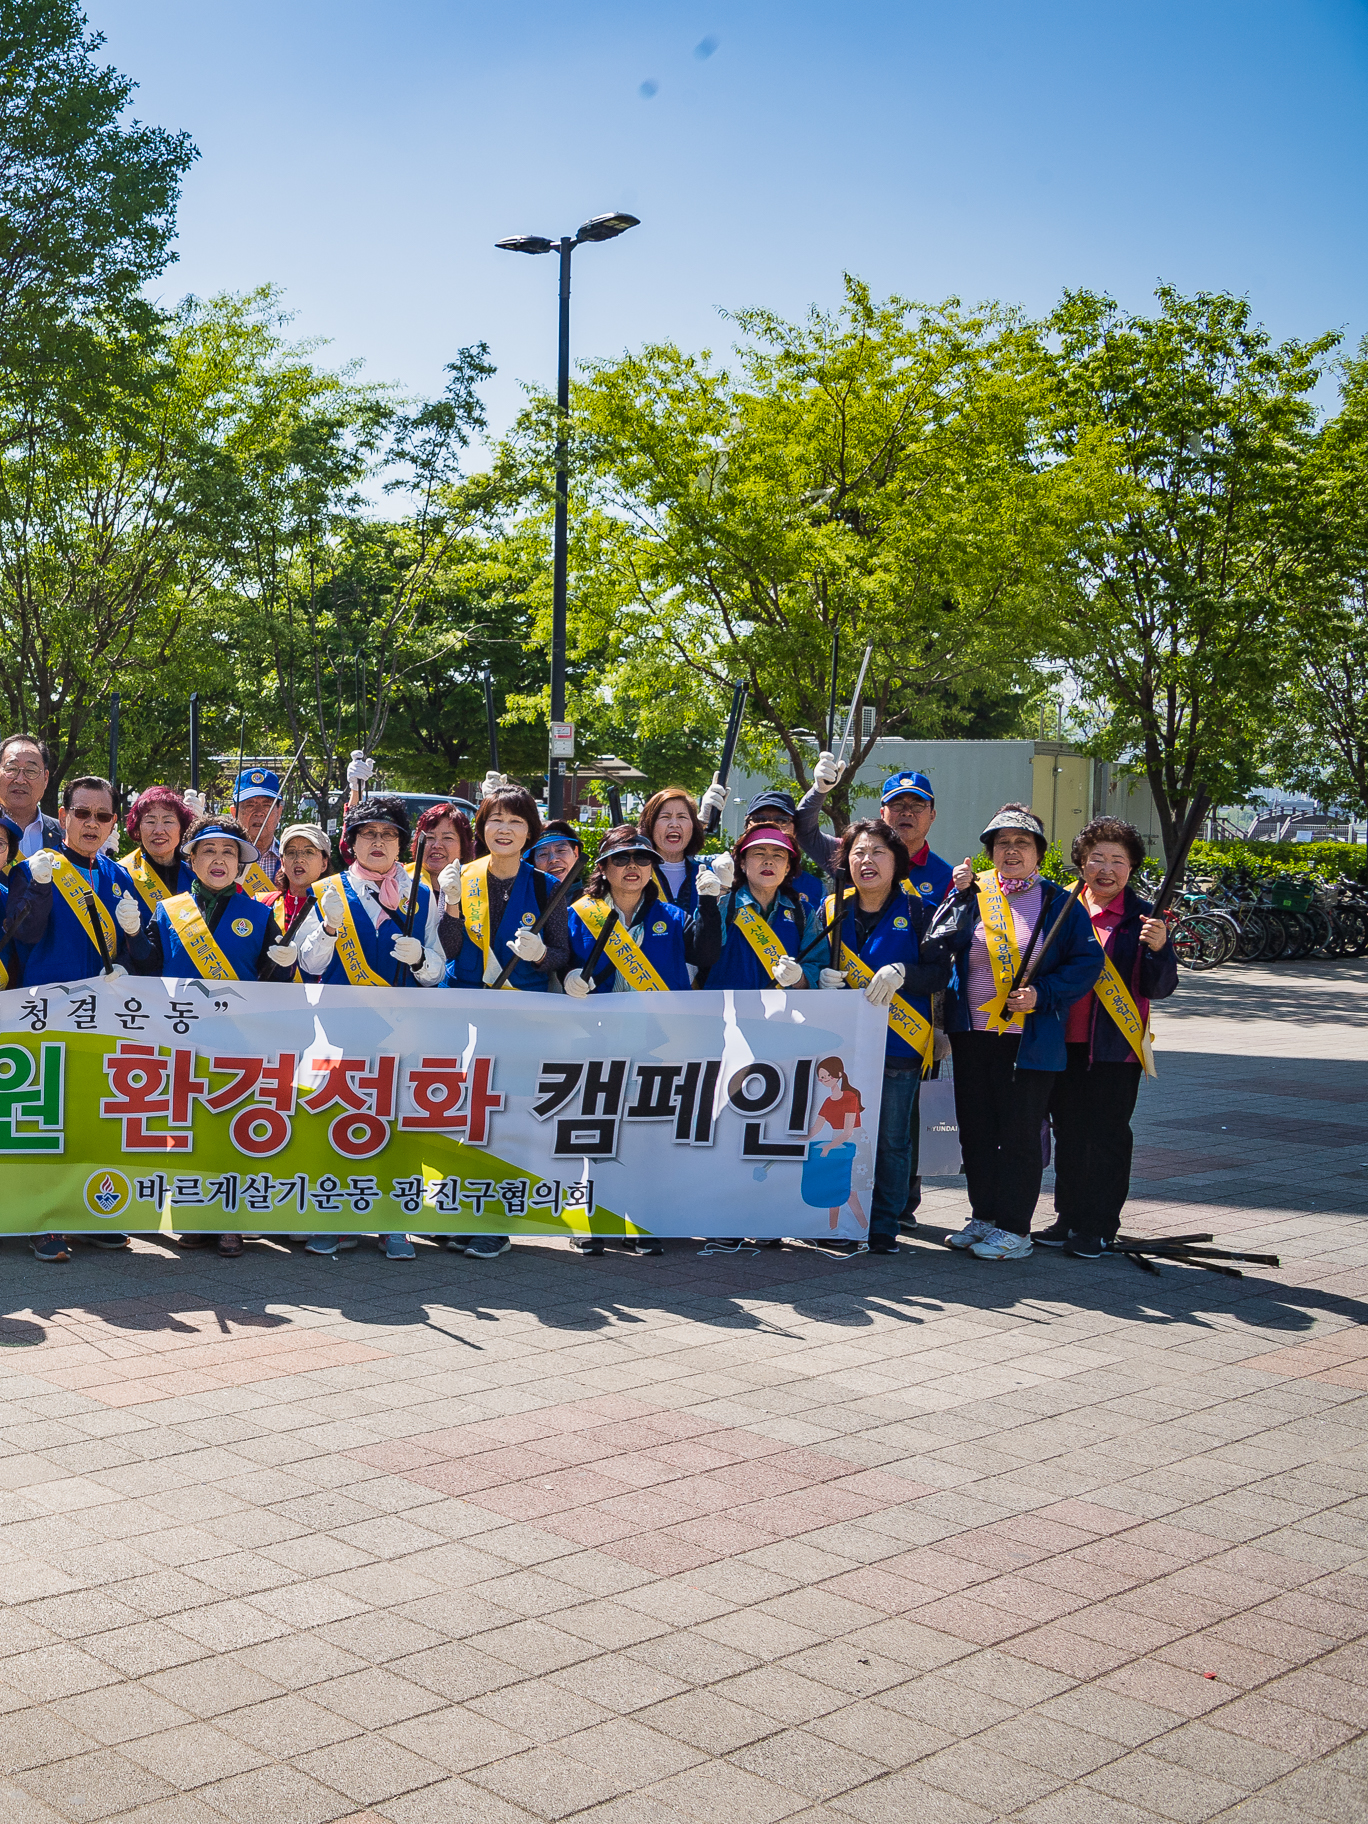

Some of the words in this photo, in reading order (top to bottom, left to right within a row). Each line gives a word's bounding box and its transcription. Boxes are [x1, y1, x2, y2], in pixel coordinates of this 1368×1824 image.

[467, 877, 482, 898] 강과
[468, 900, 483, 921] 산을
[986, 895, 1007, 931] 깨끗하게
[750, 924, 770, 946] 산을
[341, 938, 370, 983] 깨끗하게
[615, 942, 652, 984] 깨끗하게
[994, 933, 1016, 984] 이용합시다
[889, 1002, 923, 1036] 용합시다
[1105, 984, 1141, 1034] 이용합시다
[100, 1040, 506, 1159] 환경정화
[529, 1056, 817, 1162] 캠페인
[135, 1172, 382, 1216] 바르게살기운동
[393, 1176, 597, 1216] 광진구협의회
